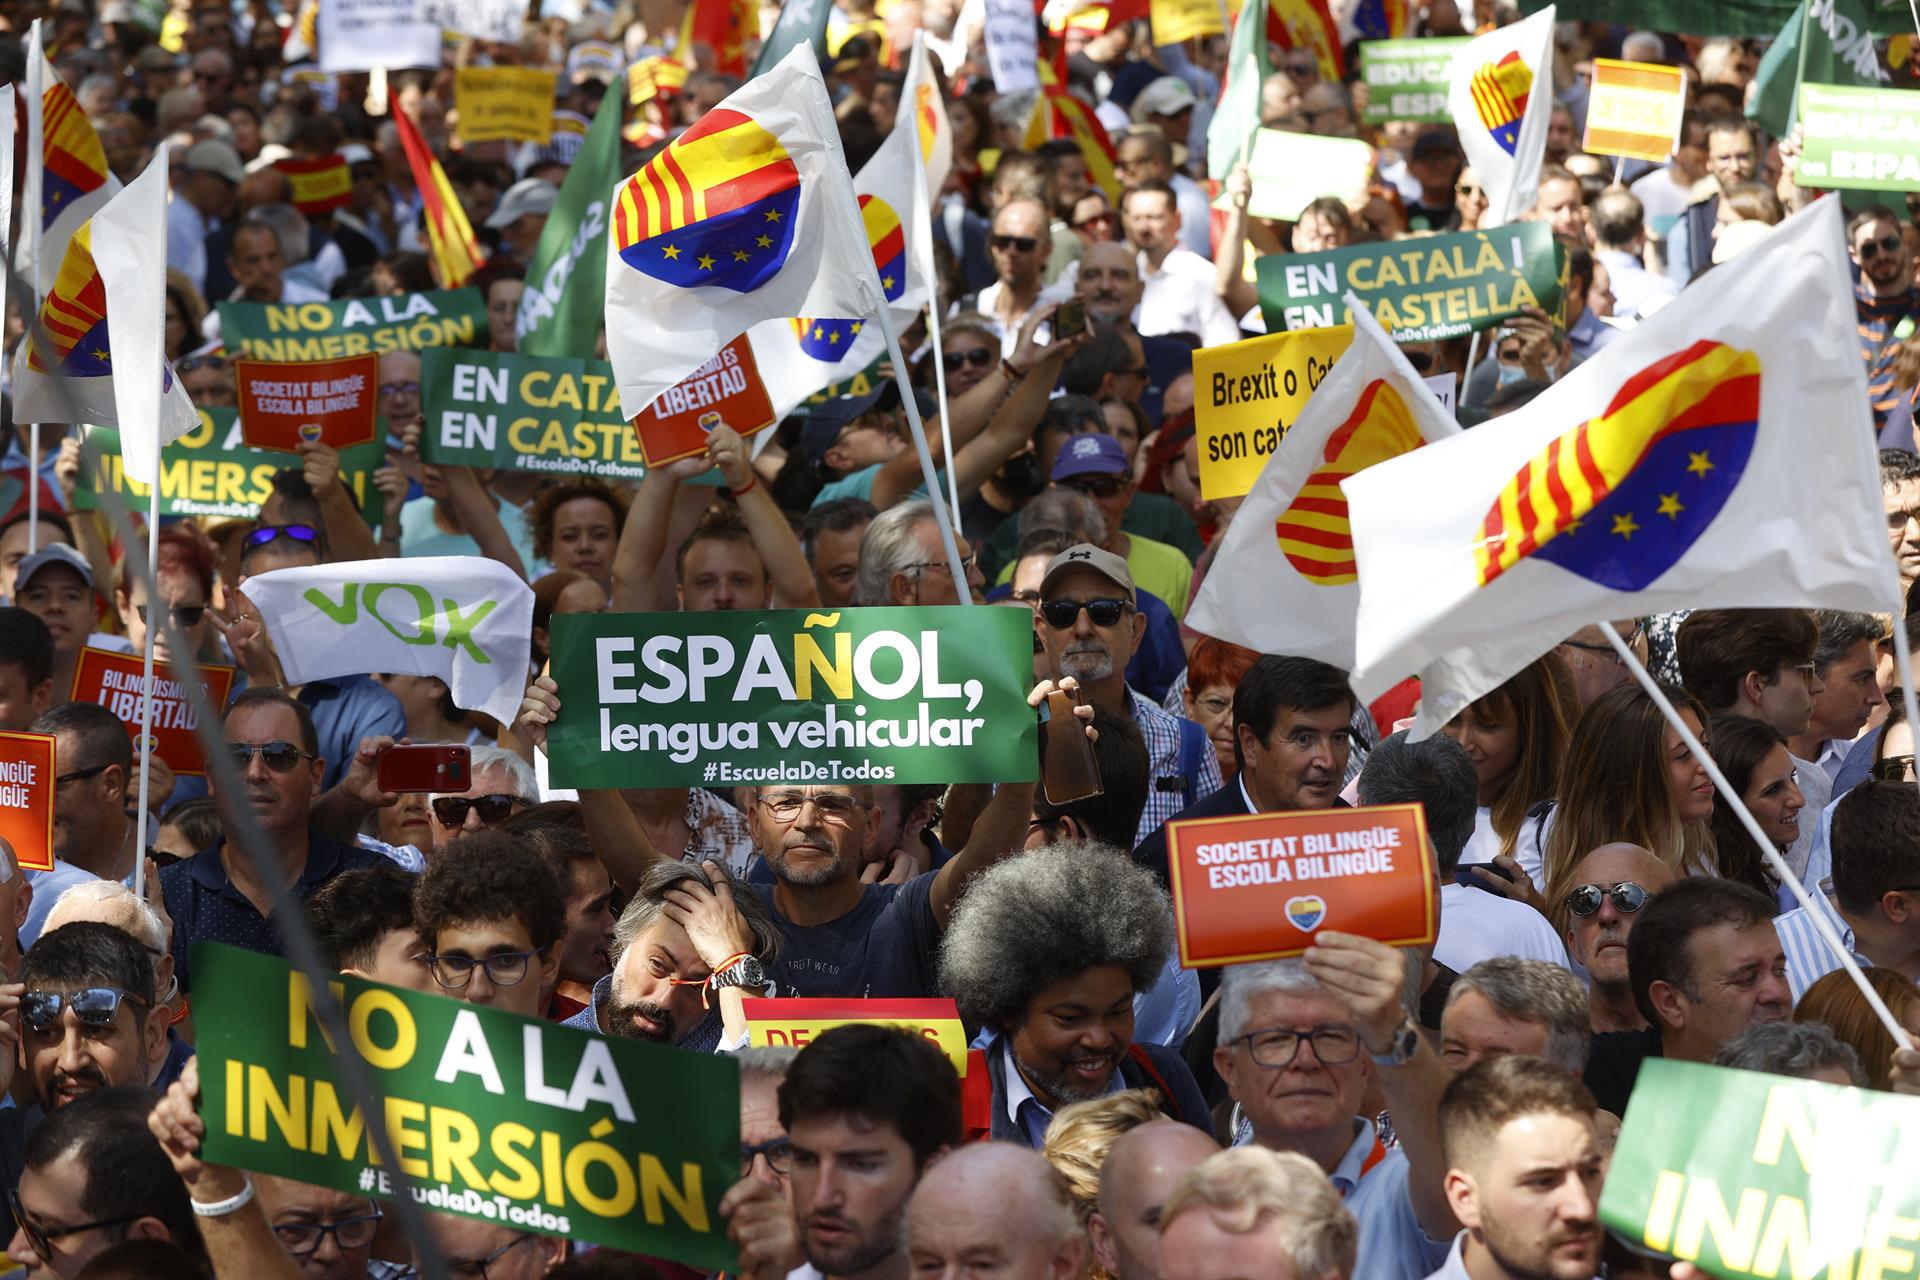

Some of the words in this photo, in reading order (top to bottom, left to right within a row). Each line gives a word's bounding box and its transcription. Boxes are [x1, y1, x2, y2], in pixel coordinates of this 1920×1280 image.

[1285, 262, 1338, 298] EN
[1346, 232, 1504, 291] CATALÀ
[265, 304, 333, 332] NO
[342, 300, 376, 328] A
[380, 293, 439, 322] LA
[721, 347, 738, 367] ES
[251, 380, 309, 399] SOCIETAT
[311, 375, 365, 397] BILINGÜE
[453, 364, 509, 404] EN
[652, 365, 747, 420] LIBERTAD
[1212, 364, 1278, 407] Br.exit
[1284, 369, 1296, 396] o
[257, 398, 304, 415] ESCOLA
[440, 410, 497, 451] EN
[1208, 432, 1247, 462] son
[516, 455, 643, 477] #EscolaDeTothom
[303, 582, 497, 664] VOX
[595, 612, 984, 713] ESPAÑOL,
[600, 707, 758, 763] lengua
[767, 702, 985, 749] vehicular
[703, 759, 895, 783] #EscuelaDeTodos
[1196, 836, 1298, 866] SOCIETAT
[1303, 826, 1401, 856] BILINGÜE
[1209, 862, 1292, 889] ESCOLA
[1296, 848, 1394, 881] BILINGÜE
[435, 1009, 505, 1094] A
[523, 1024, 637, 1123] LA
[225, 1059, 711, 1232] INMERSIÓN
